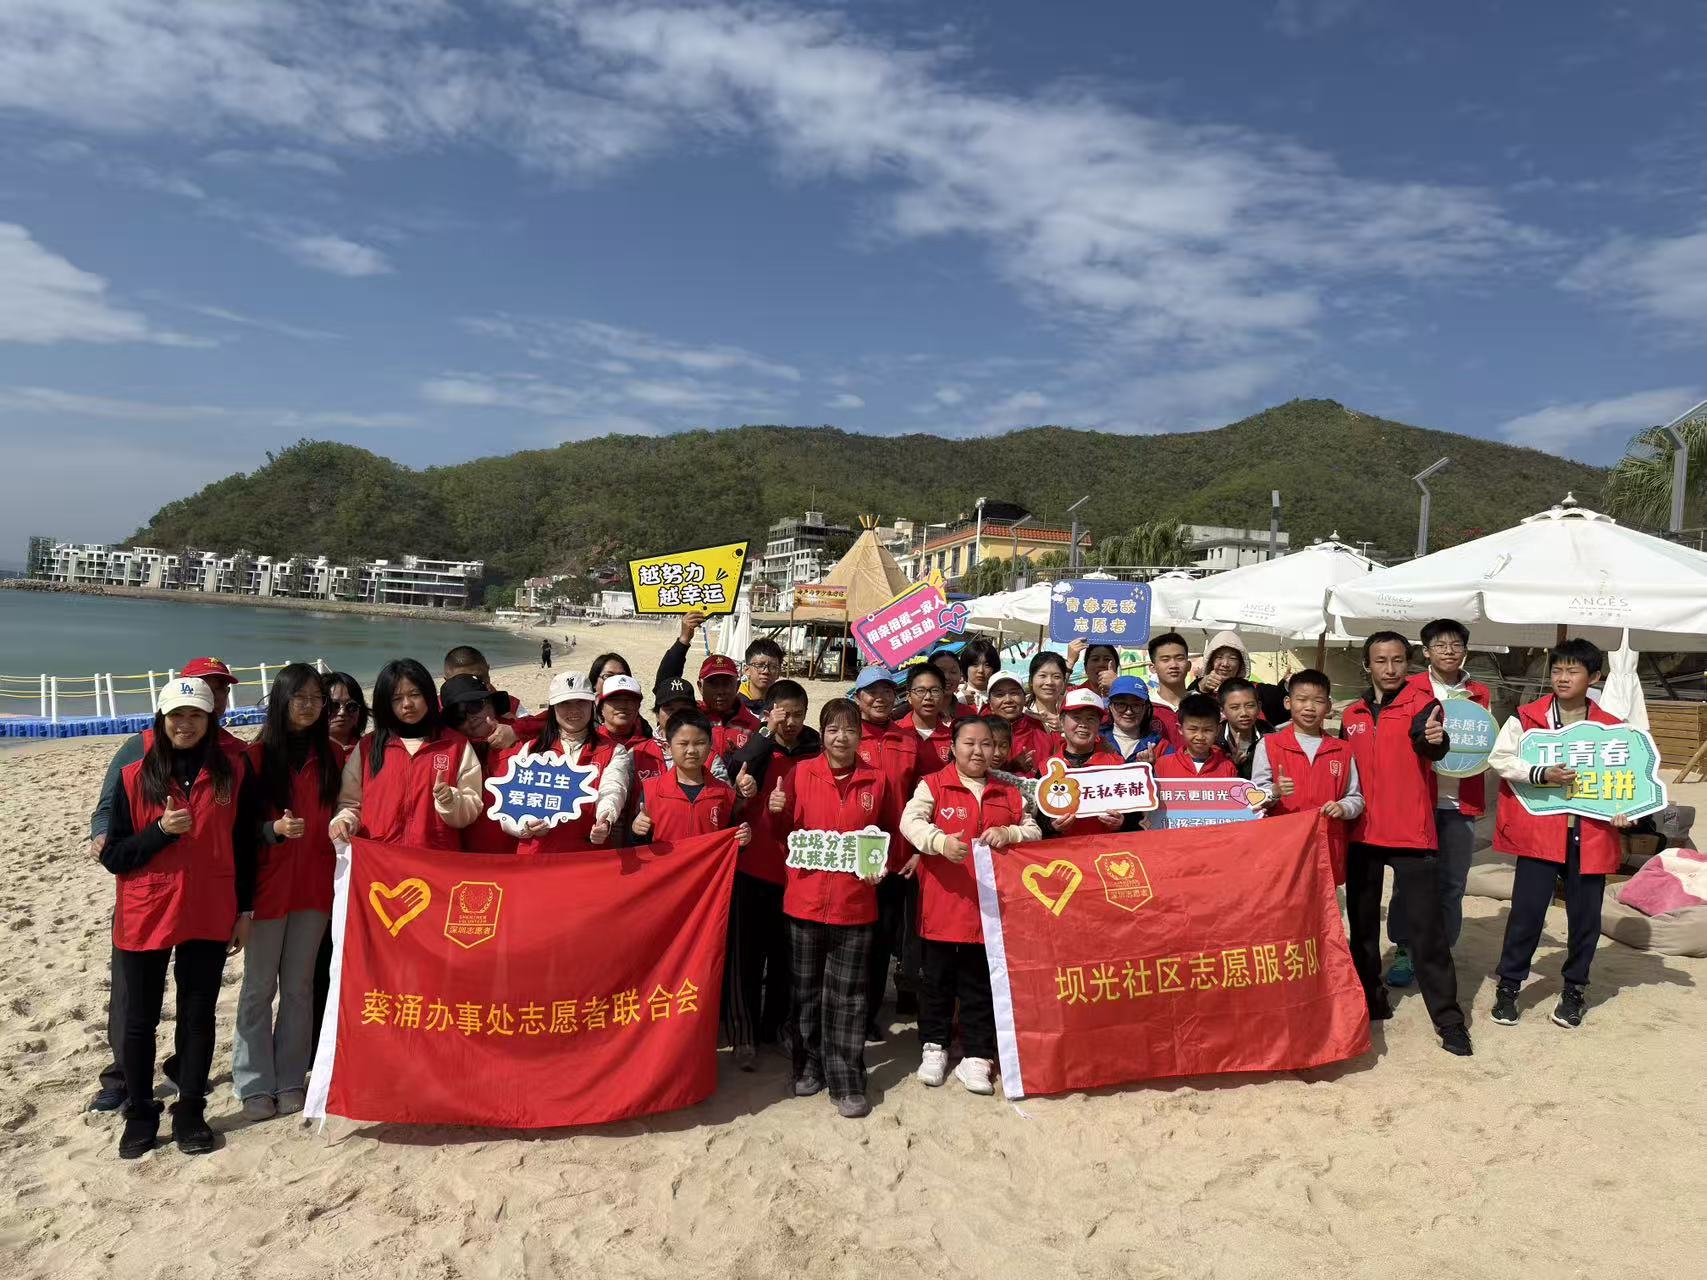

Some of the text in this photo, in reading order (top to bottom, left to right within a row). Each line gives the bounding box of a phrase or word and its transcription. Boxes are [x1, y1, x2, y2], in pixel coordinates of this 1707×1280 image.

[639, 562, 705, 586] 越努力
[659, 583, 726, 607] 越幸运
[1065, 597, 1137, 614] 青春无敌
[866, 594, 945, 645] 相亲相爱一家人
[1073, 616, 1127, 634] 志愿者
[888, 617, 936, 650] 互帮互助
[180, 682, 194, 695] LA
[1536, 738, 1631, 768] 正青春
[517, 769, 571, 790] 讲卫生
[508, 790, 562, 811] 爱家园
[1081, 781, 1145, 800] 无私奉献
[1160, 789, 1229, 801] 明天更阳光
[791, 833, 857, 853] 垃圾分类
[789, 850, 857, 870] 从我先行
[1055, 938, 1321, 1005] 坝光社区志愿服务队
[360, 977, 700, 1036] 葵涌办事处志愿者联合会
